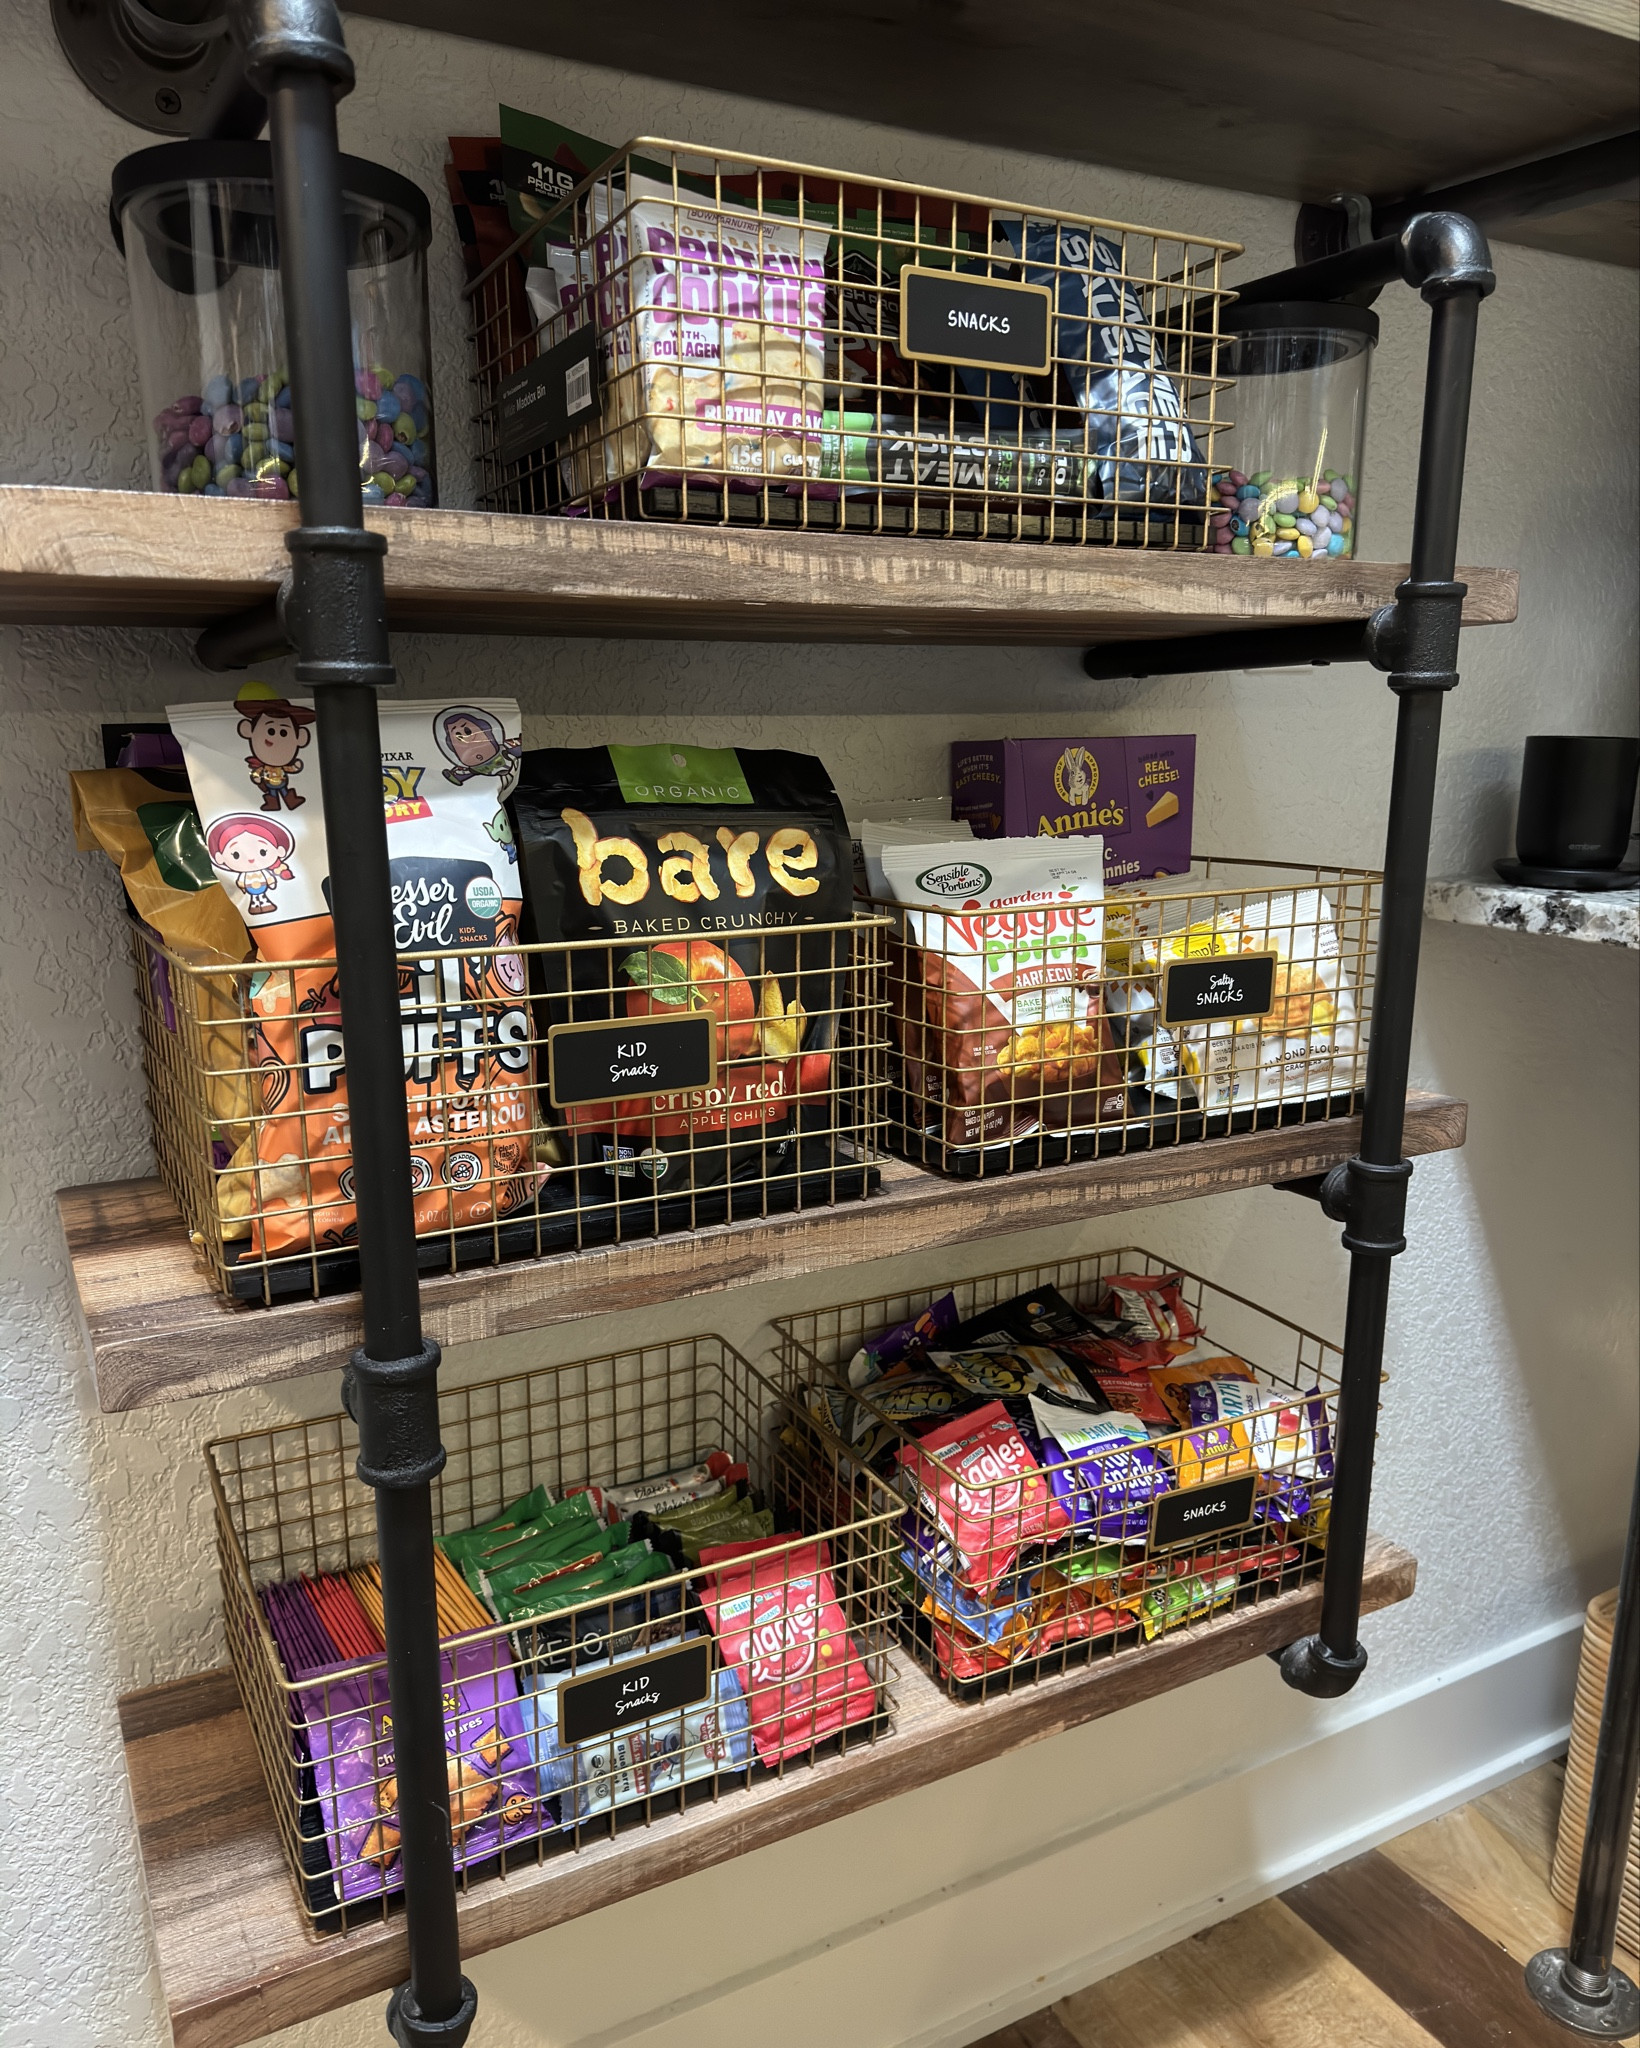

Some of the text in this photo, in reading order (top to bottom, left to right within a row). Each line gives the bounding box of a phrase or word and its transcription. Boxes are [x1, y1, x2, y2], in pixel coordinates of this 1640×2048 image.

[532, 160, 575, 191] 11G
[690, 209, 772, 236] BOWMARNUTRITON
[646, 226, 826, 291] PROTEIN
[652, 273, 826, 342] COOKIES
[946, 309, 1011, 335] SNACKS
[1060, 234, 1167, 461] SAUSAGE
[1092, 240, 1193, 464] SUMMER
[791, 413, 823, 439] CAK
[885, 429, 994, 457] STICK
[730, 444, 763, 468] 15G
[782, 453, 822, 469] GLUTE
[885, 457, 991, 486] MEAT
[1137, 770, 1180, 789] CHEESE!
[1144, 760, 1171, 774] REAL
[382, 765, 426, 802] OY
[634, 785, 740, 800] ORGANIC
[384, 801, 423, 818] ORY
[1037, 799, 1125, 838] Annie's
[560, 807, 821, 907] bare
[1103, 859, 1141, 880] nnies
[925, 864, 971, 886] Sensible
[937, 875, 982, 895] Portions
[391, 876, 459, 907] esser
[471, 898, 499, 909] ORGANIC
[472, 886, 495, 897] USDA
[989, 889, 1054, 910] garden
[393, 902, 455, 950] Evil
[458, 926, 476, 936] KIDS
[613, 910, 799, 935] BAKED CRUNCHY
[931, 899, 1096, 951] Veggie
[459, 934, 488, 944] SNACKS
[1179, 942, 1221, 958] mple
[984, 932, 1089, 973] PUFFS
[1015, 967, 1081, 988] BARECUE
[1208, 972, 1235, 990] Salty
[1016, 998, 1043, 1008] BAKE
[1196, 988, 1244, 1007] SNACKS
[616, 1041, 648, 1060] KID
[609, 1062, 660, 1083] Snacks
[1284, 1060, 1322, 1072] CRACERS
[652, 1085, 738, 1114] crispy
[413, 1101, 527, 1136] ASTEROID
[679, 1106, 777, 1129] APPLE CHIS
[426, 1209, 439, 1222] OZ
[440, 1209, 464, 1222] (7g)
[1215, 1381, 1243, 1420] ARTH
[1061, 1421, 1121, 1446] YUMEARTH
[937, 1442, 961, 1459] EARTH
[962, 1446, 985, 1468] ORGANIC
[949, 1435, 1026, 1513] giggles
[1103, 1463, 1165, 1494] snacks
[633, 1481, 670, 1499] Blake's
[1182, 1500, 1227, 1521] SNACKS
[739, 1593, 823, 1678] giggles
[528, 1631, 603, 1668] KEO
[621, 1676, 651, 1696] KID
[614, 1690, 661, 1716] Snacks
[444, 1716, 484, 1742] quares
[702, 1724, 712, 1758] orgnic
[705, 1713, 725, 1759] SKUT
[616, 1744, 630, 1793] Blueerry
[633, 1753, 644, 1776] SNCK
